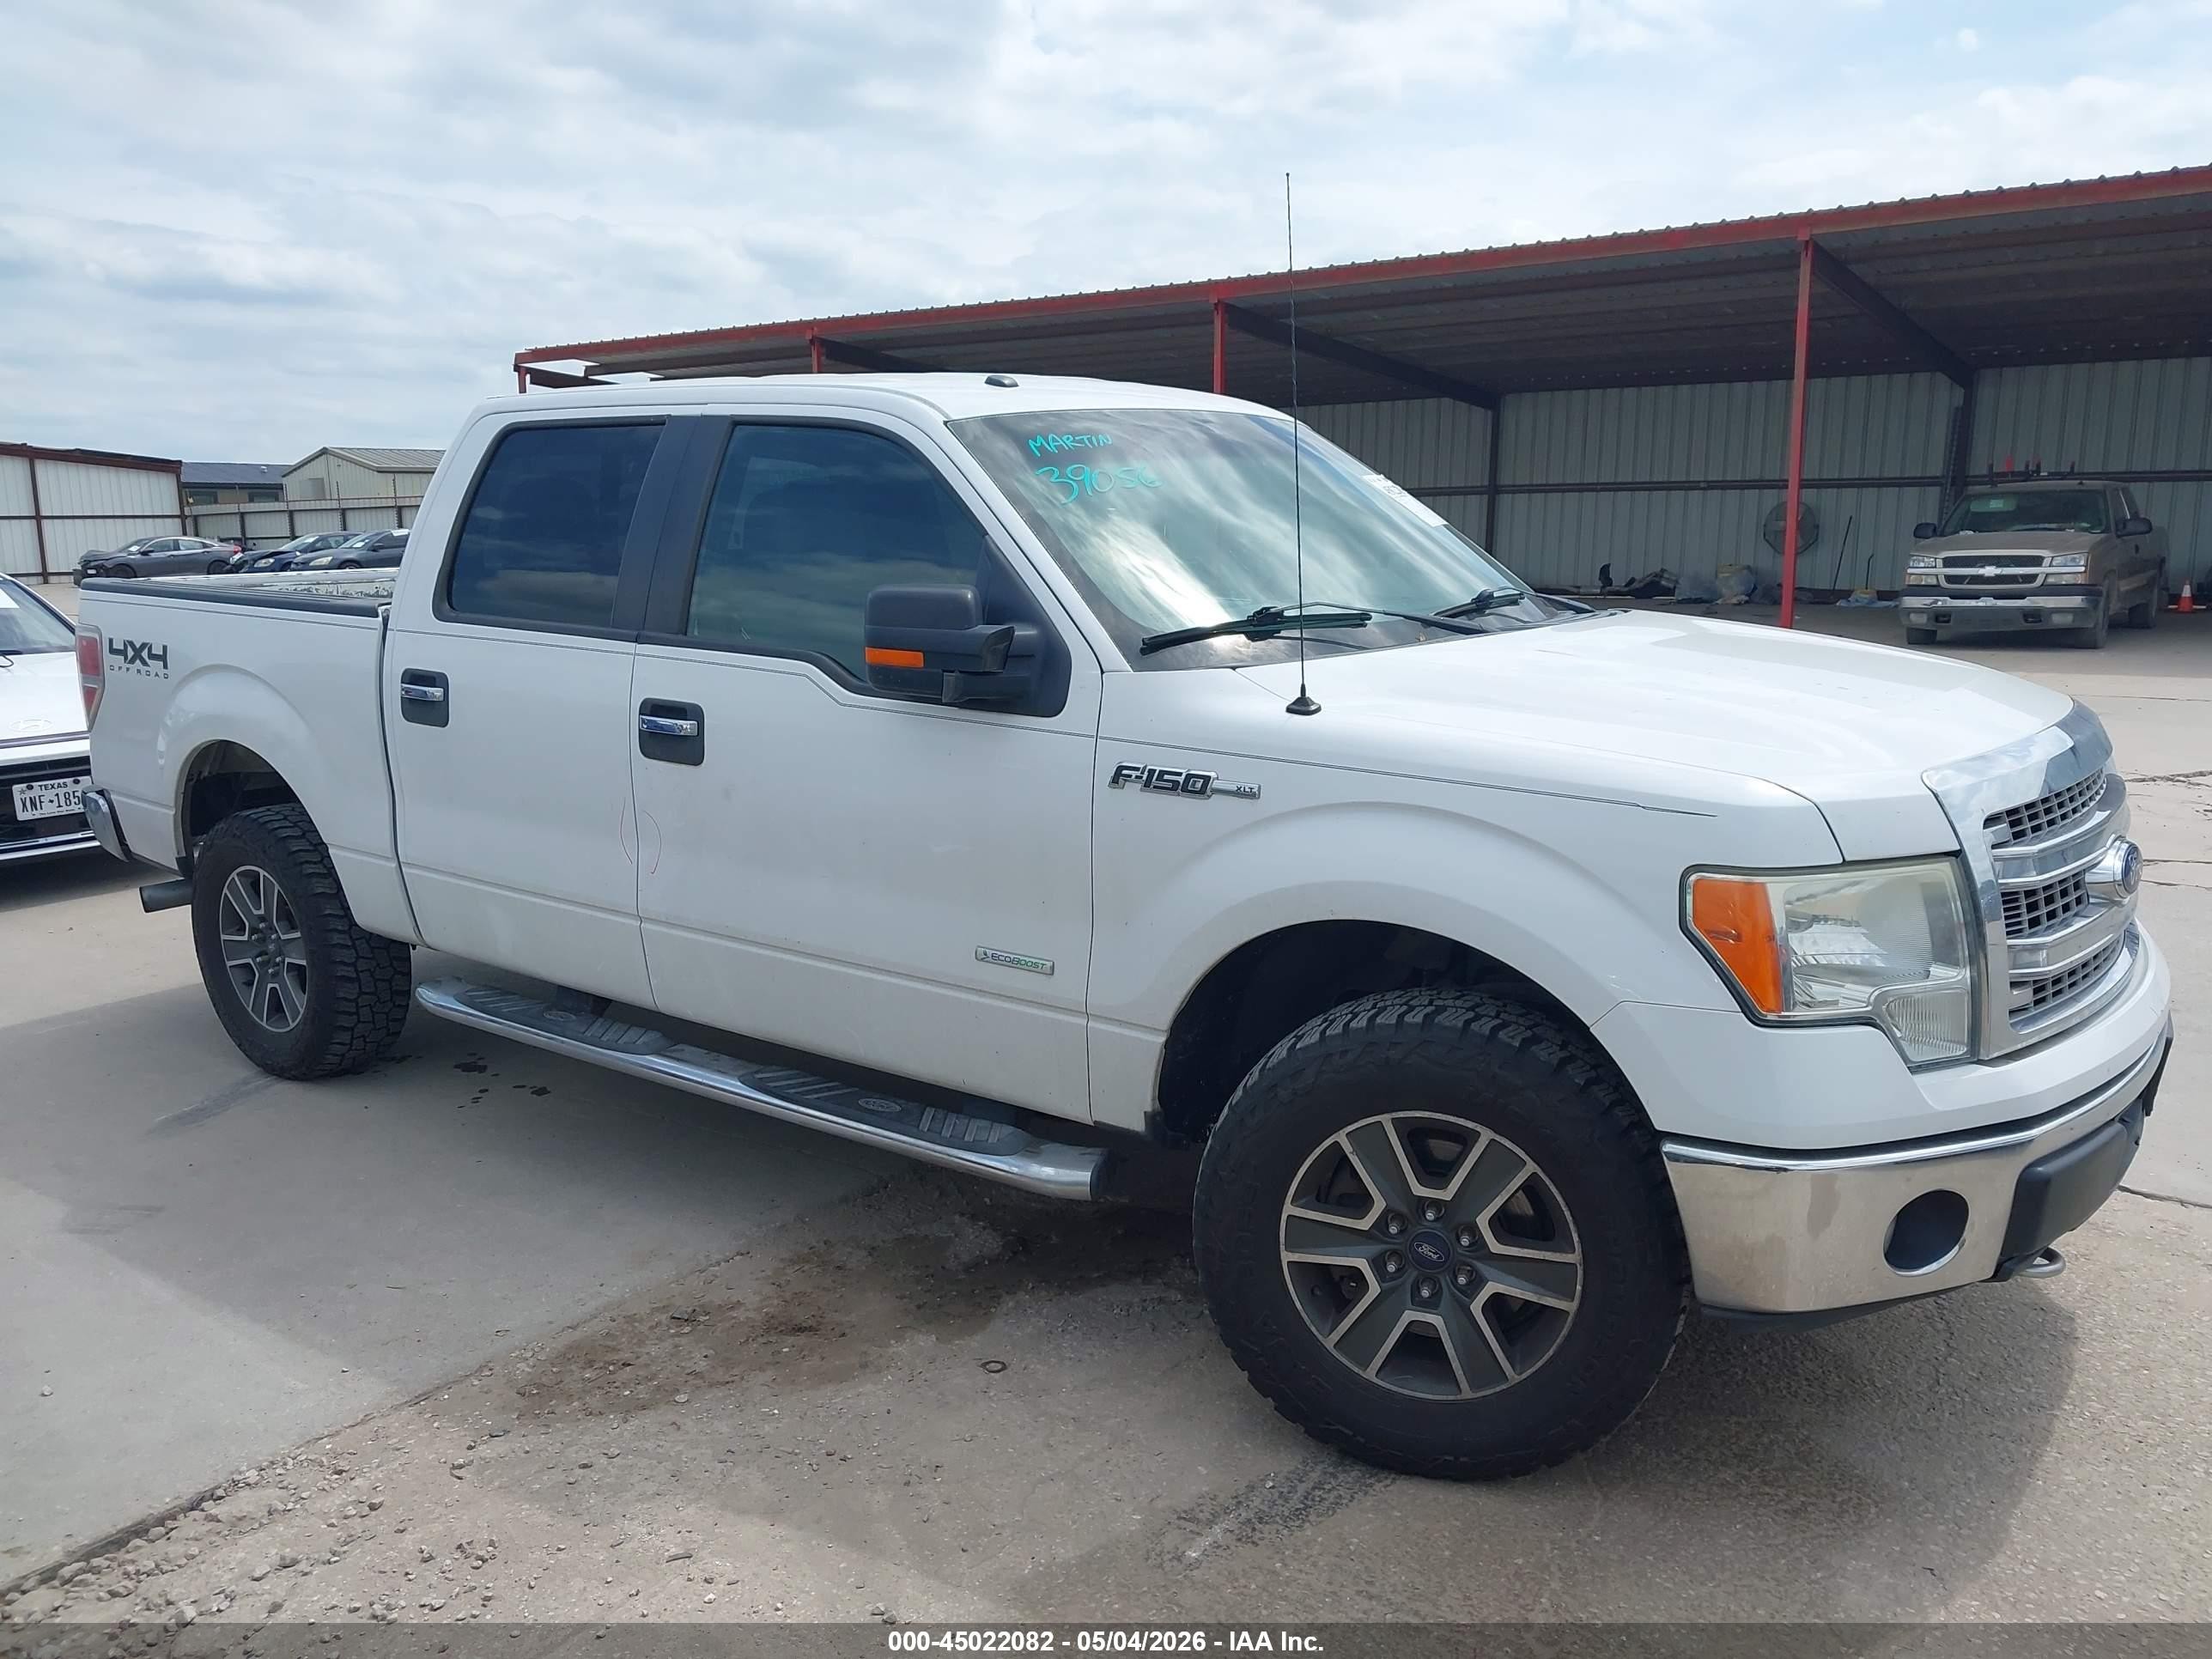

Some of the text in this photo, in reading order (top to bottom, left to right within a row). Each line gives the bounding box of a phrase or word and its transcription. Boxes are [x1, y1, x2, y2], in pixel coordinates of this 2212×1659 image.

[1028, 433, 1113, 457] MARTIN
[137, 669, 168, 678] ROAD
[38, 781, 68, 791] TEXAS
[1108, 761, 1255, 799] F-150 XLT
